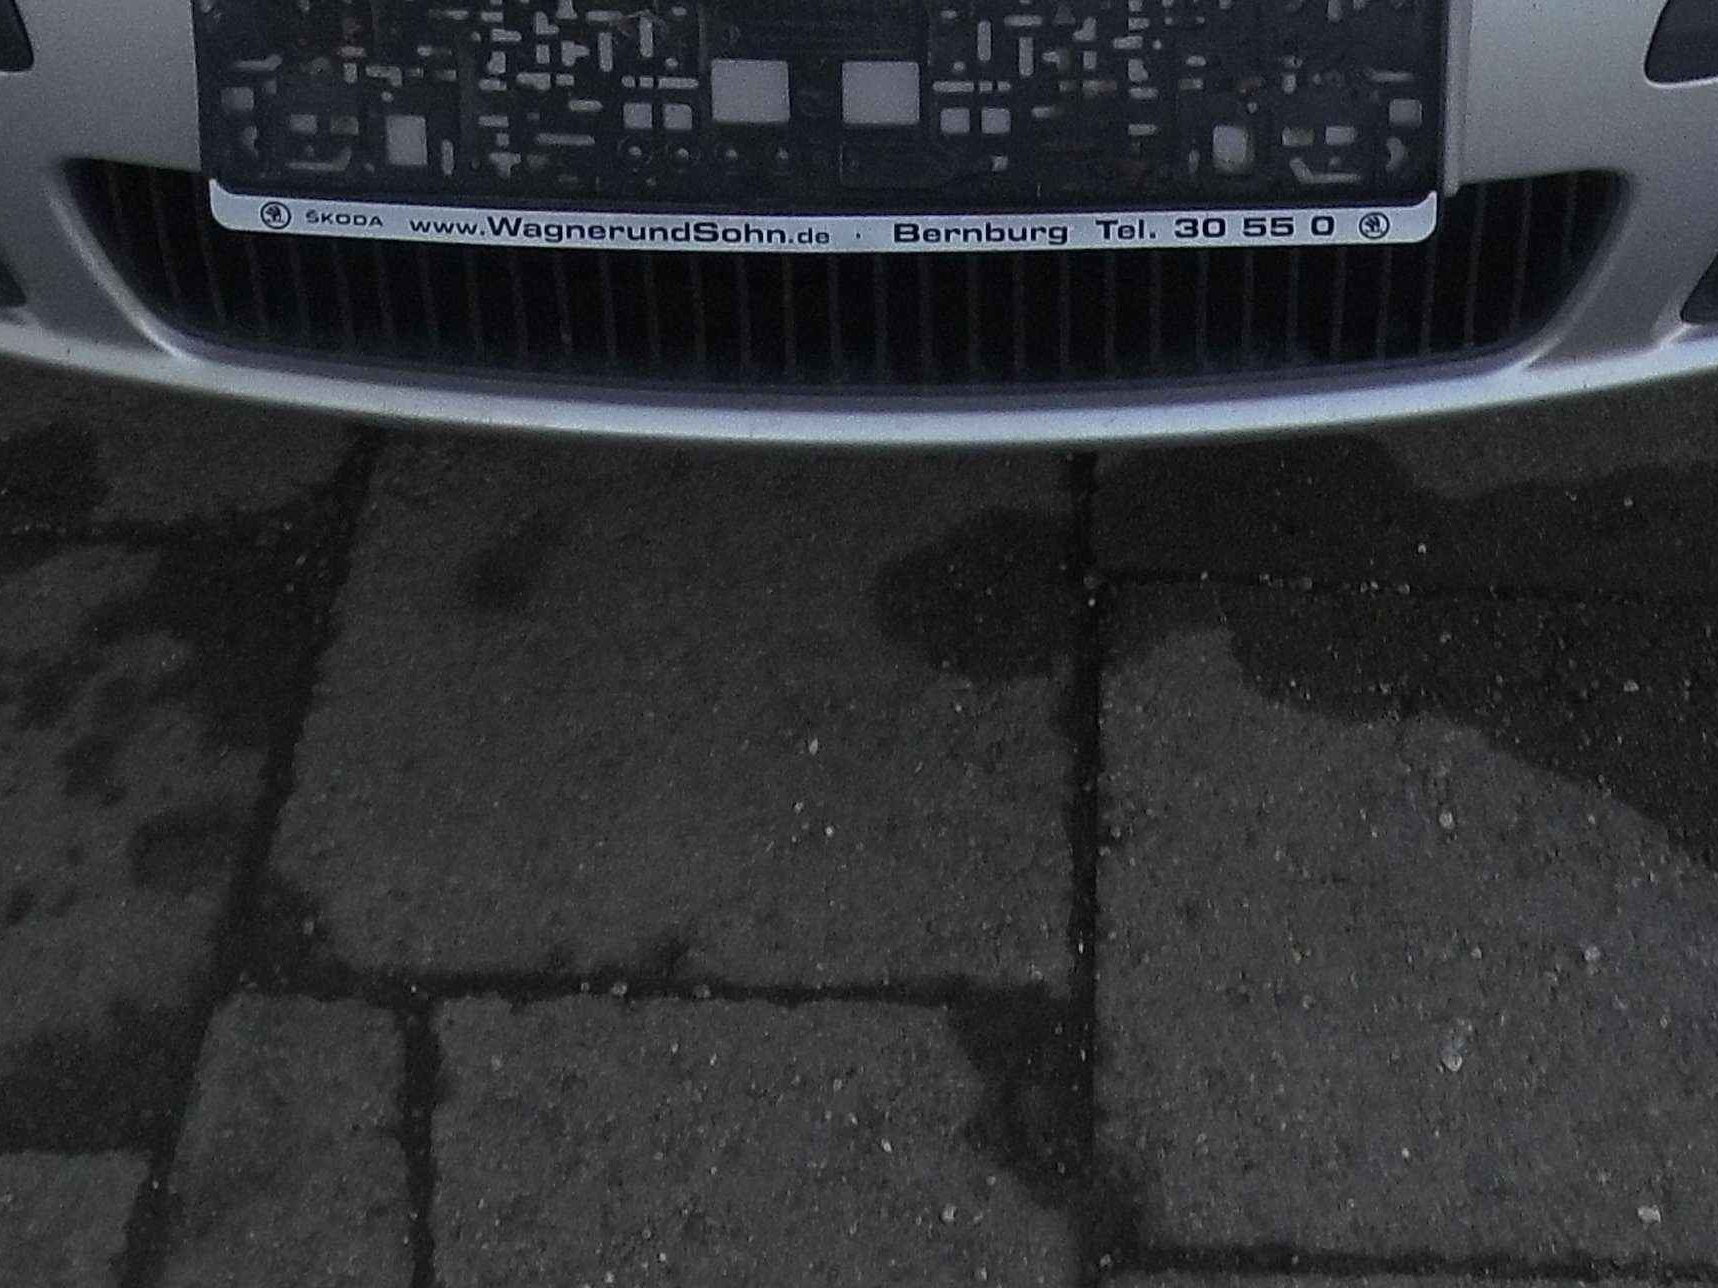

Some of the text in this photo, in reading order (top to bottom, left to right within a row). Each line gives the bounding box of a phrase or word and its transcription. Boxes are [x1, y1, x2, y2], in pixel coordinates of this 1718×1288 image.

[409, 215, 830, 244] www.WagnerundSohn.de
[893, 222, 1069, 246] Bernburg
[1095, 219, 1156, 240] Tel.
[1174, 217, 1226, 239] 30
[1243, 216, 1294, 238] 55
[1311, 214, 1335, 237] 0
